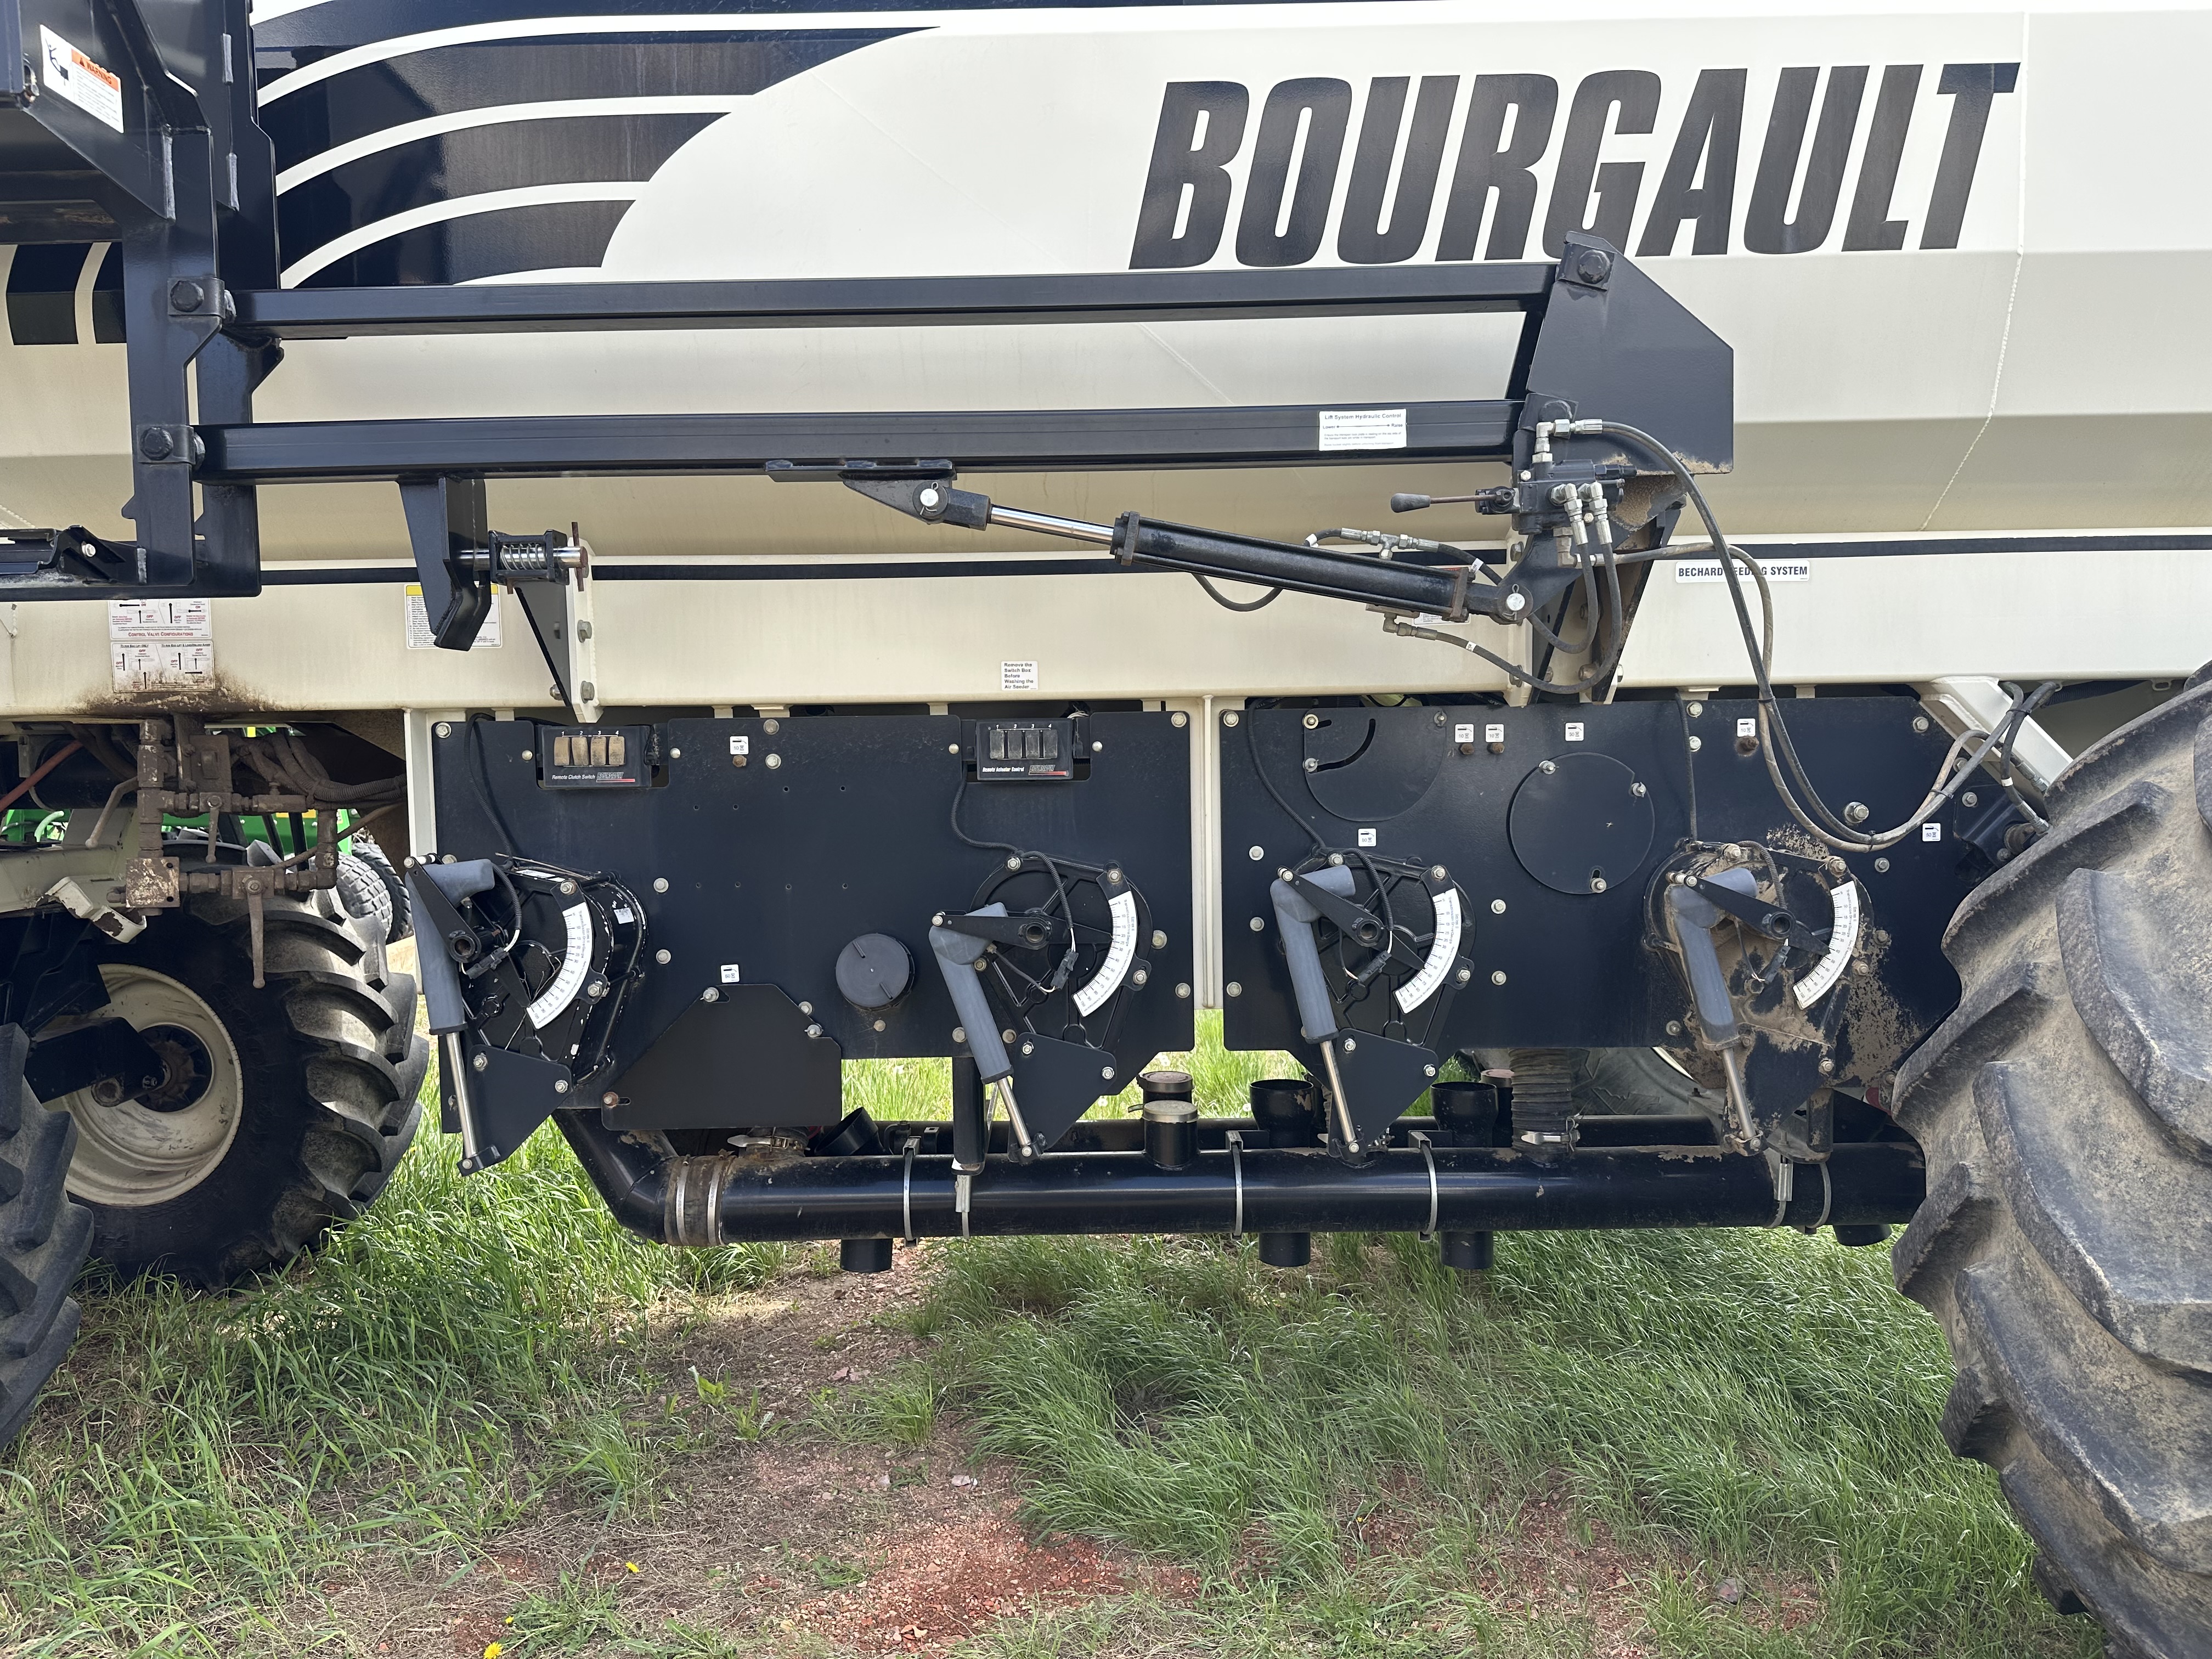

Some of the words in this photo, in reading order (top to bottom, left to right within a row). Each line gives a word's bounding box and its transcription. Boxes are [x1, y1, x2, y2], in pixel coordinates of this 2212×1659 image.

[86, 62, 112, 84] WARNING
[1129, 61, 2020, 269] BOURGAULT
[1679, 567, 1723, 576] BECHARD
[1725, 567, 1767, 575] EEDG
[1771, 566, 1807, 575] SYSTEM
